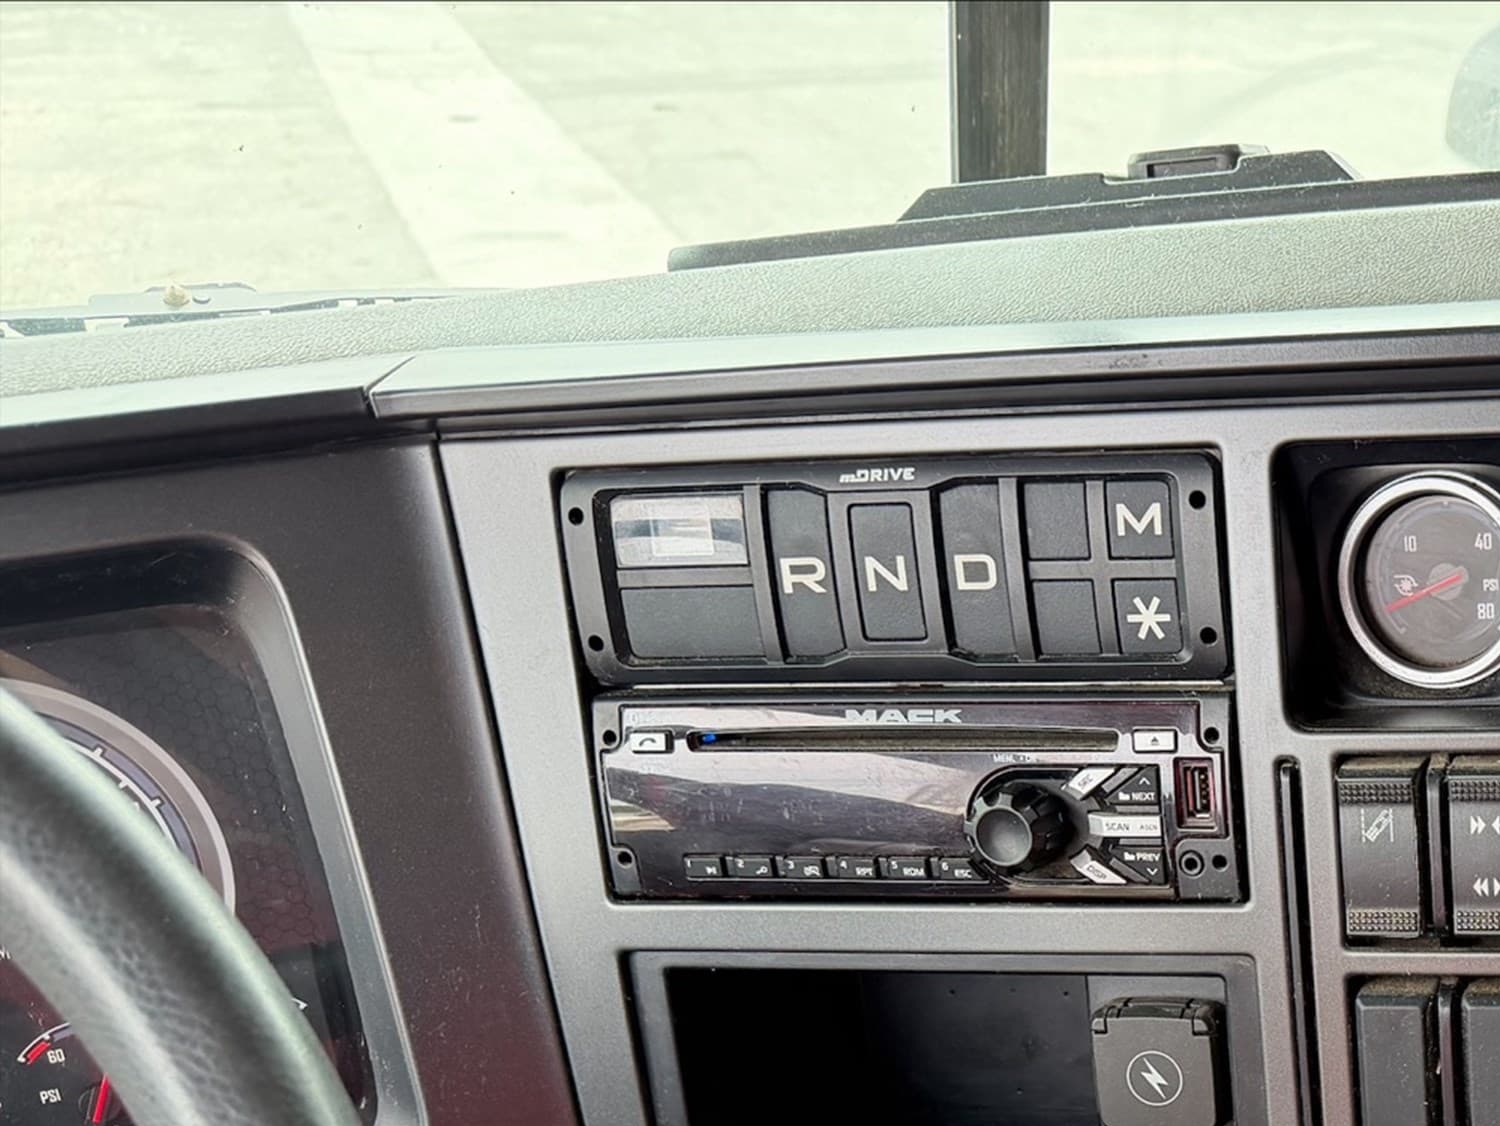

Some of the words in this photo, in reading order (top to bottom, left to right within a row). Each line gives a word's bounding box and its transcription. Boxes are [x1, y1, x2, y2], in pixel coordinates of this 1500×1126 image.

[839, 467, 915, 483] mDRIVE
[1116, 502, 1163, 535] M
[1403, 535, 1417, 553] 10
[1474, 532, 1492, 551] 40
[780, 556, 827, 594] R
[865, 555, 909, 592] N
[954, 553, 997, 591] D
[1482, 577, 1499, 592] PSI
[1477, 602, 1495, 620] 80
[845, 709, 962, 723] MACK
[1132, 792, 1155, 800] NEXT
[1105, 822, 1130, 832] SCAN
[1136, 852, 1160, 861] PREV
[954, 869, 973, 878] ESC
[47, 1048, 66, 1064] 60
[39, 1088, 61, 1104] PSI
